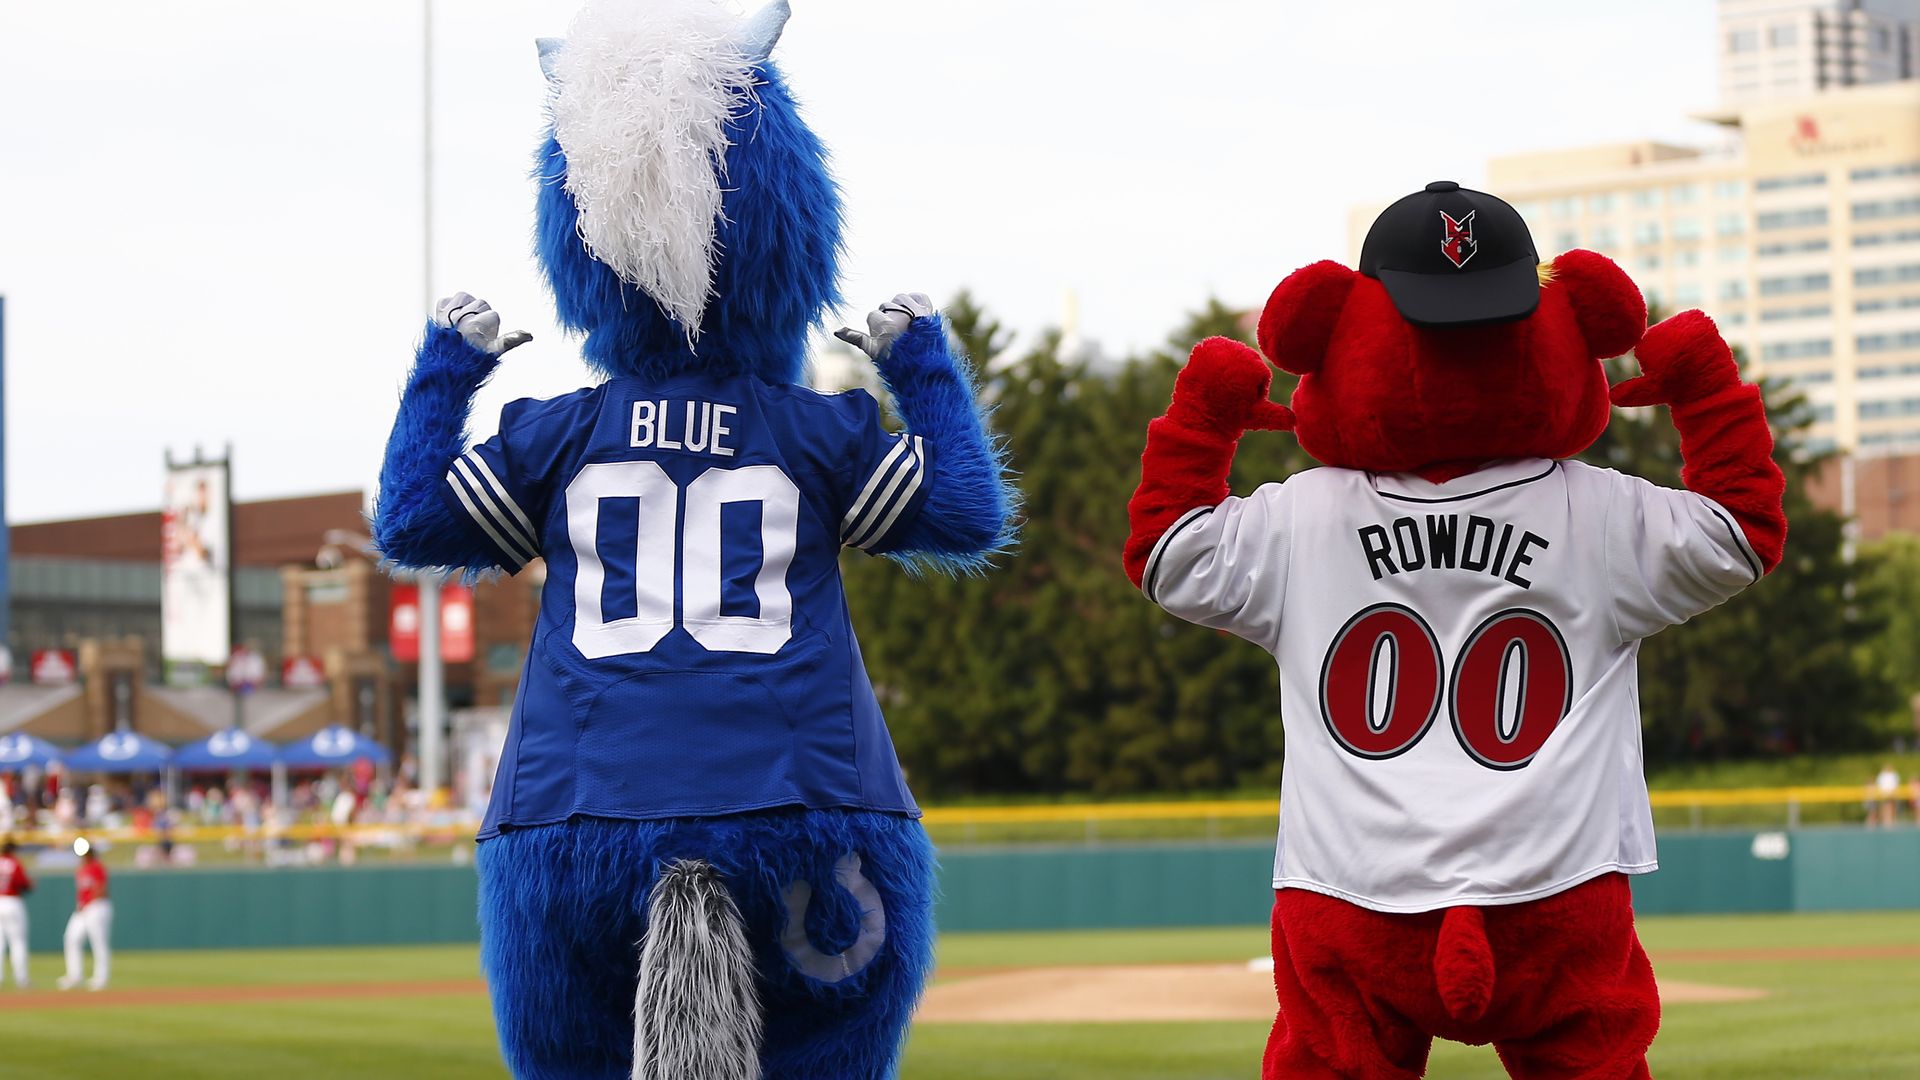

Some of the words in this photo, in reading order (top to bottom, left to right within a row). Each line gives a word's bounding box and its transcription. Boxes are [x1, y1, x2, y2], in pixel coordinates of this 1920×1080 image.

[630, 400, 737, 456] BLUE
[565, 460, 800, 660] 00
[1357, 514, 1550, 590] ROWDIE
[1318, 602, 1574, 772] 00
